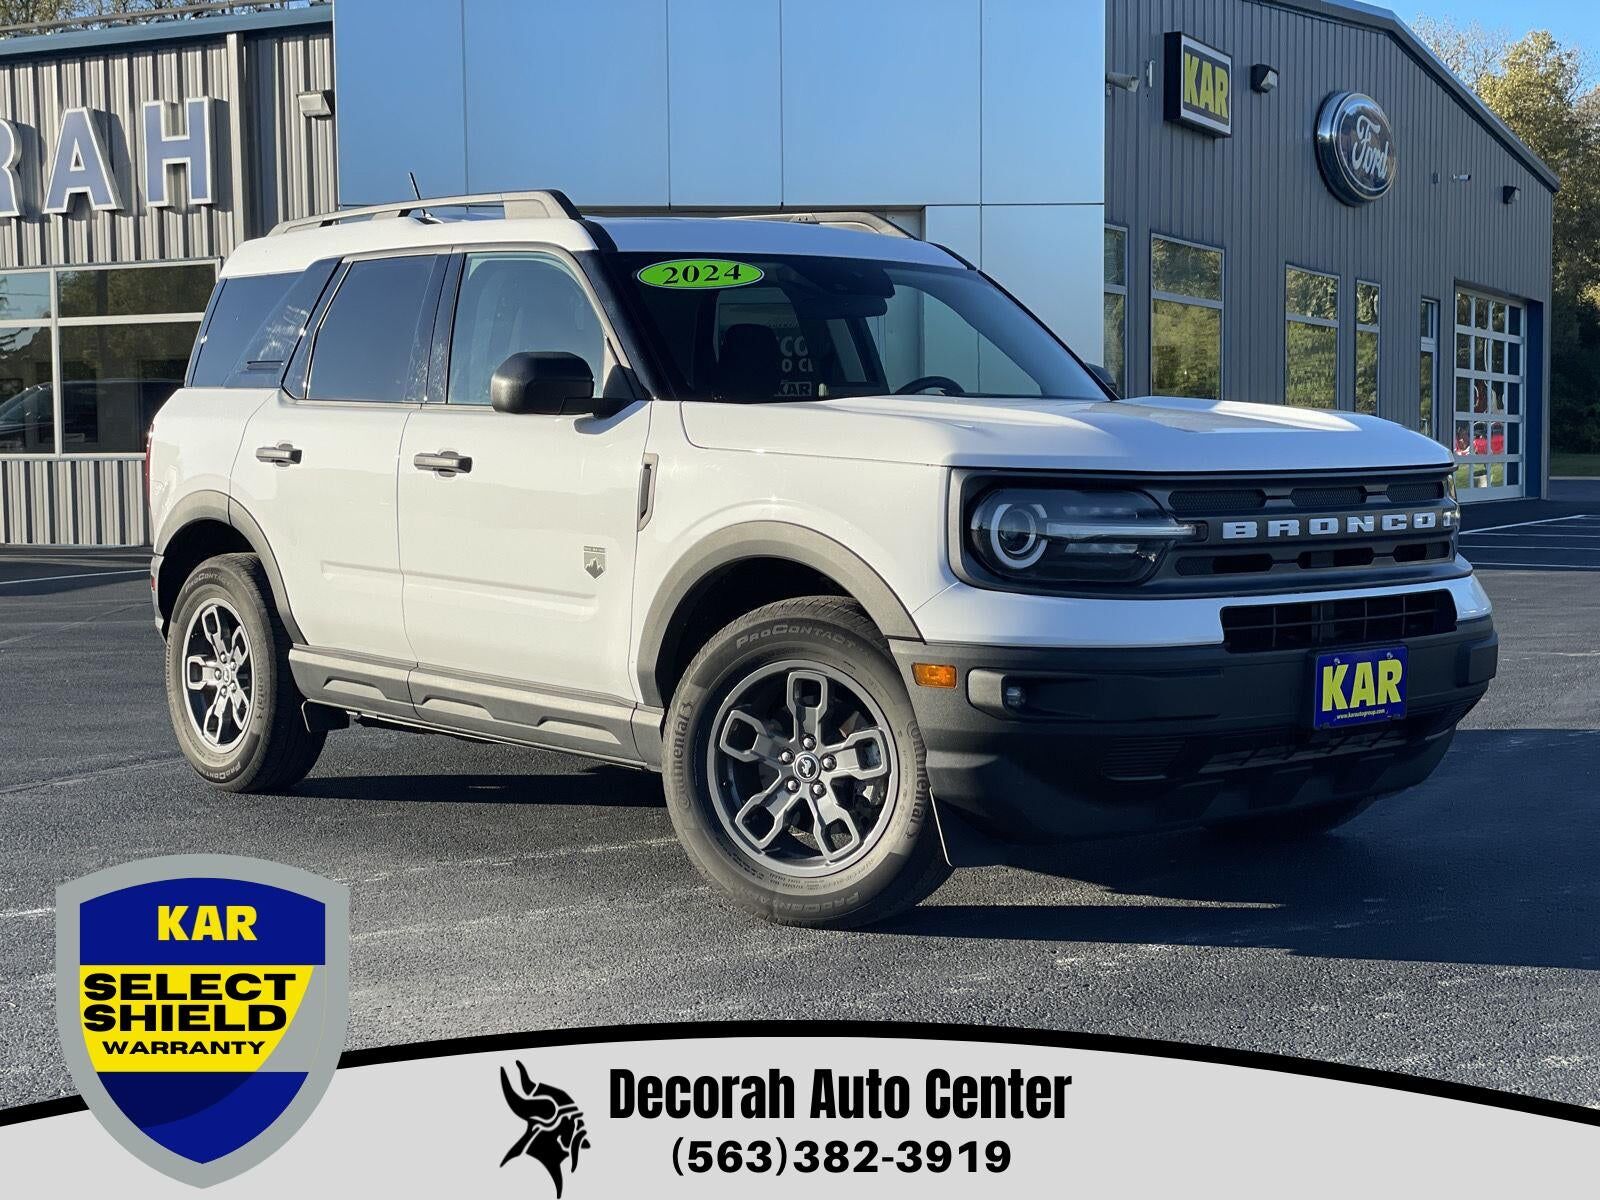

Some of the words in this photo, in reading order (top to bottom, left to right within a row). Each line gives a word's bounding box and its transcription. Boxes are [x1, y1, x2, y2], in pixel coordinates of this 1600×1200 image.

[1184, 52, 1229, 119] KAR
[1352, 115, 1389, 179] Ford
[661, 264, 742, 285] 2024
[1222, 511, 1437, 540] BRONCO
[1321, 659, 1402, 712] KAR
